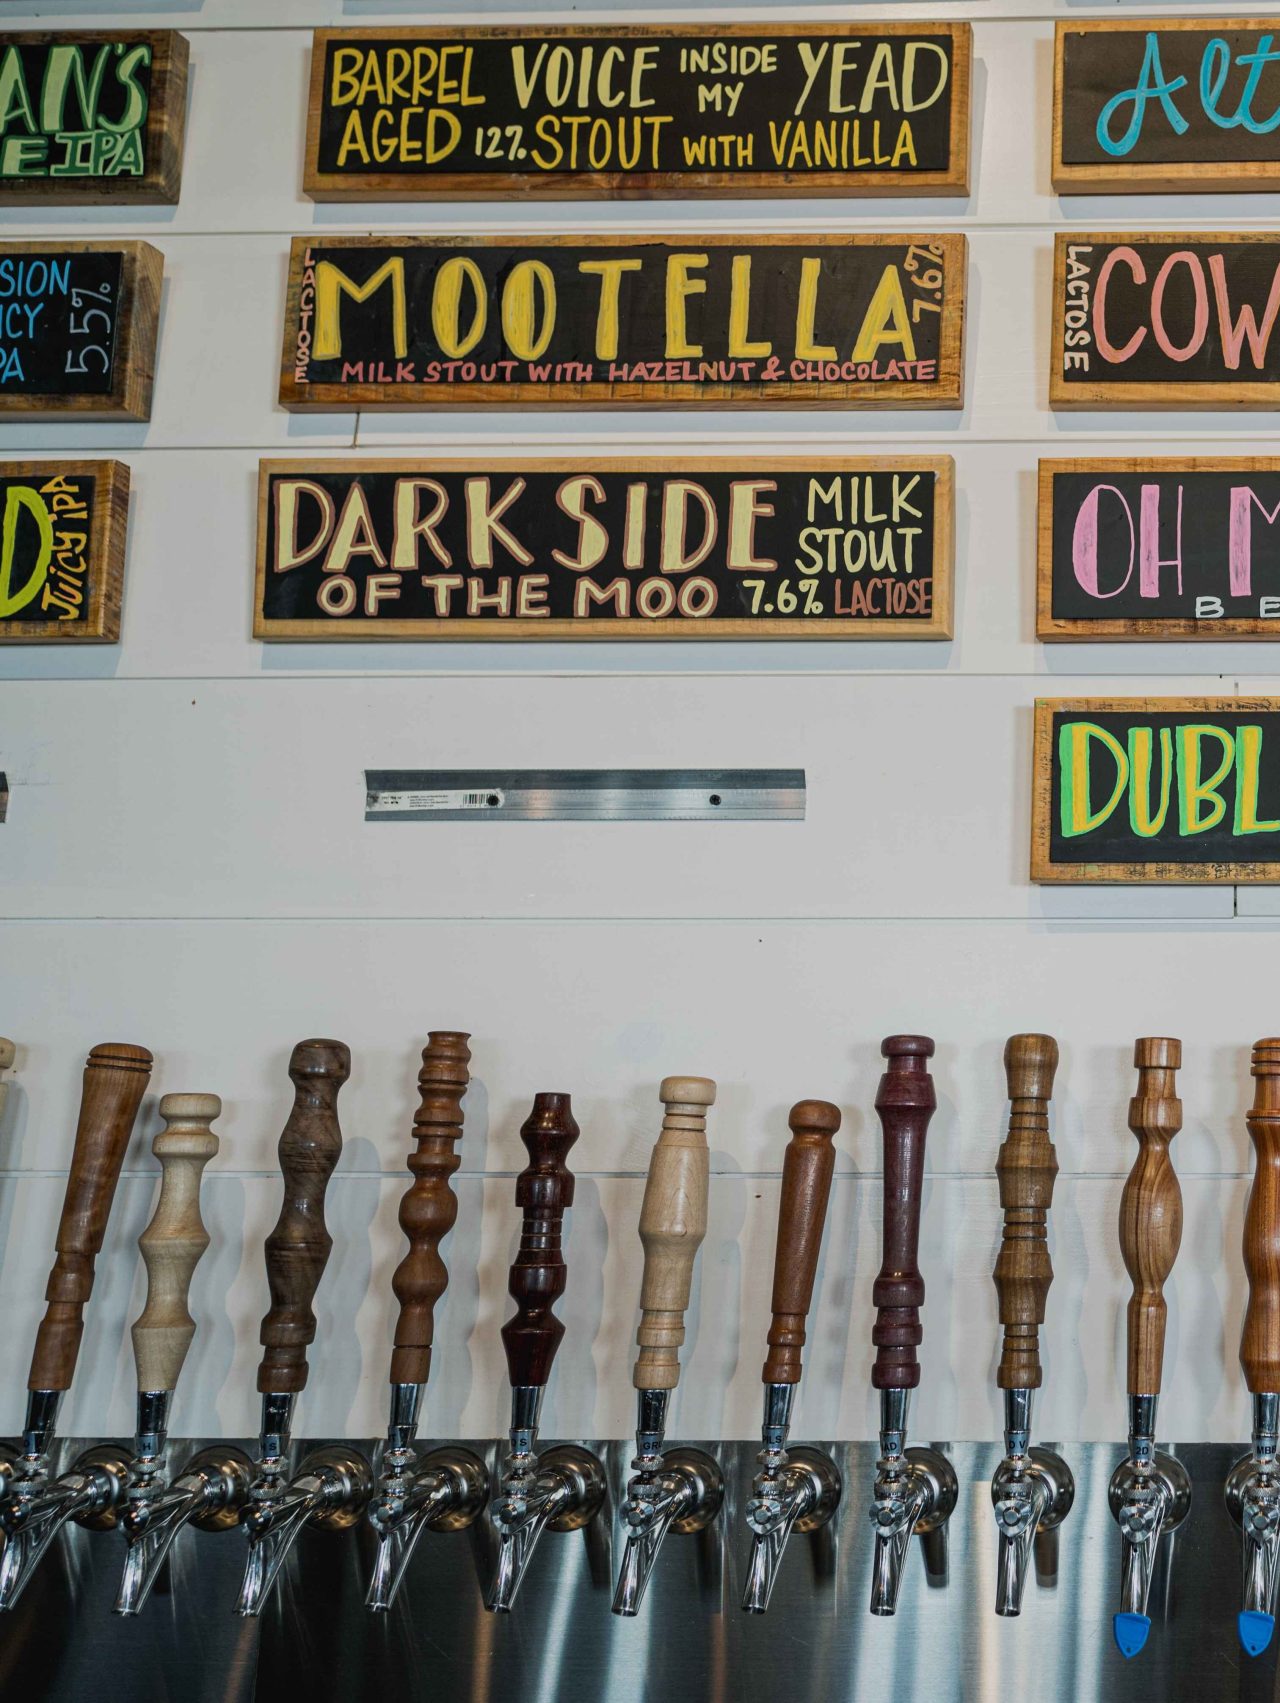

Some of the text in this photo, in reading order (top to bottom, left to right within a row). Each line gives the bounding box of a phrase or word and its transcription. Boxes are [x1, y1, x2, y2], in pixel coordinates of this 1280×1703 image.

[331, 45, 486, 106] BARREL
[511, 42, 949, 117] VOICE INSIDE MY YEAD
[50, 129, 144, 176] IPA
[337, 107, 918, 170] AGED 12% STOUT WITH VANILLA
[0, 302, 44, 339] CY
[64, 282, 112, 374] 5.5%
[293, 248, 317, 384] LACTOSE
[312, 253, 918, 363] MOOTELLA
[1063, 245, 1093, 372] LACTOSE
[341, 356, 937, 383] MILK STOUT WITH HAZELNUT & CHOCOLATE
[273, 475, 778, 573] DARK SIDE
[807, 474, 922, 524] MILK
[795, 526, 923, 575] STOUT
[1072, 484, 1184, 599] OH
[316, 574, 719, 618] OF THE MOO
[742, 579, 823, 615] 7.6%
[834, 577, 932, 616] LACTOSE
